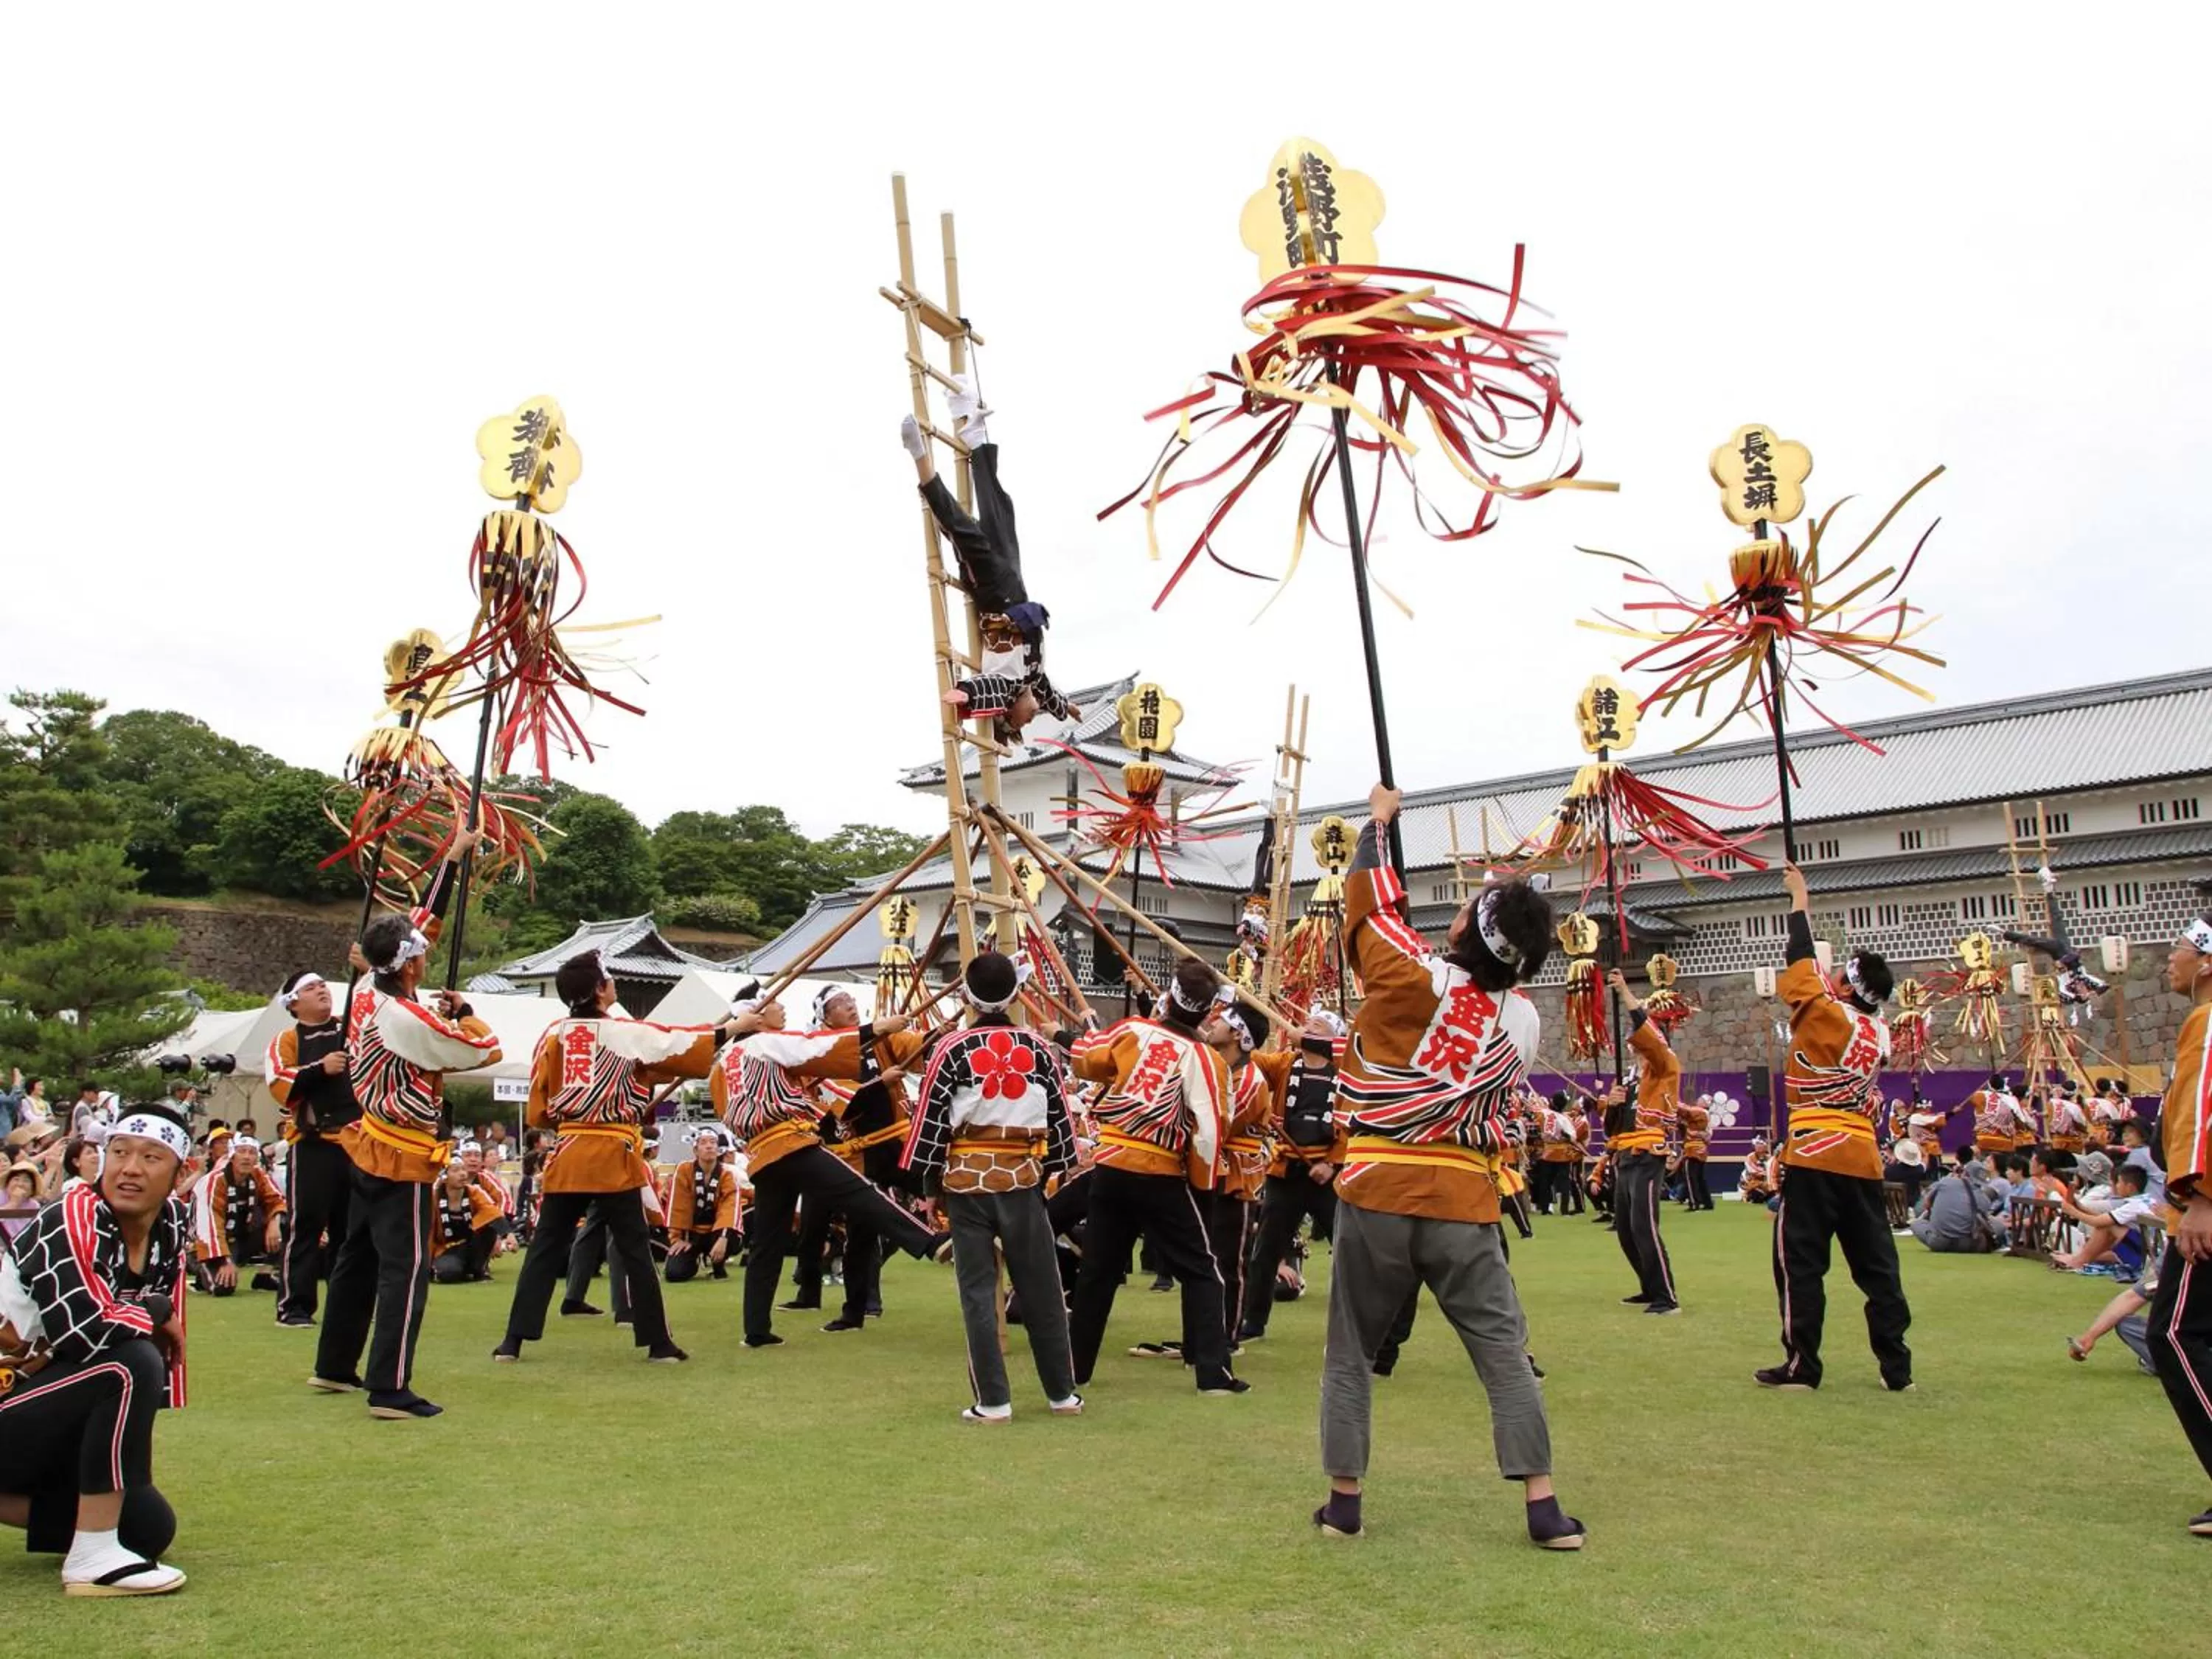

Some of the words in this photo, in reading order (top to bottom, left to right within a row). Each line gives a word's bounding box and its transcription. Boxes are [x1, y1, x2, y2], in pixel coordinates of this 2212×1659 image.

[1739, 431, 1778, 510] 長土塀
[1325, 824, 1346, 862] 森山
[566, 1026, 595, 1084] 金沢
[1417, 979, 1498, 1083] 金沢
[1843, 1016, 1879, 1076] 金沢
[1127, 1040, 1179, 1102] 金沢
